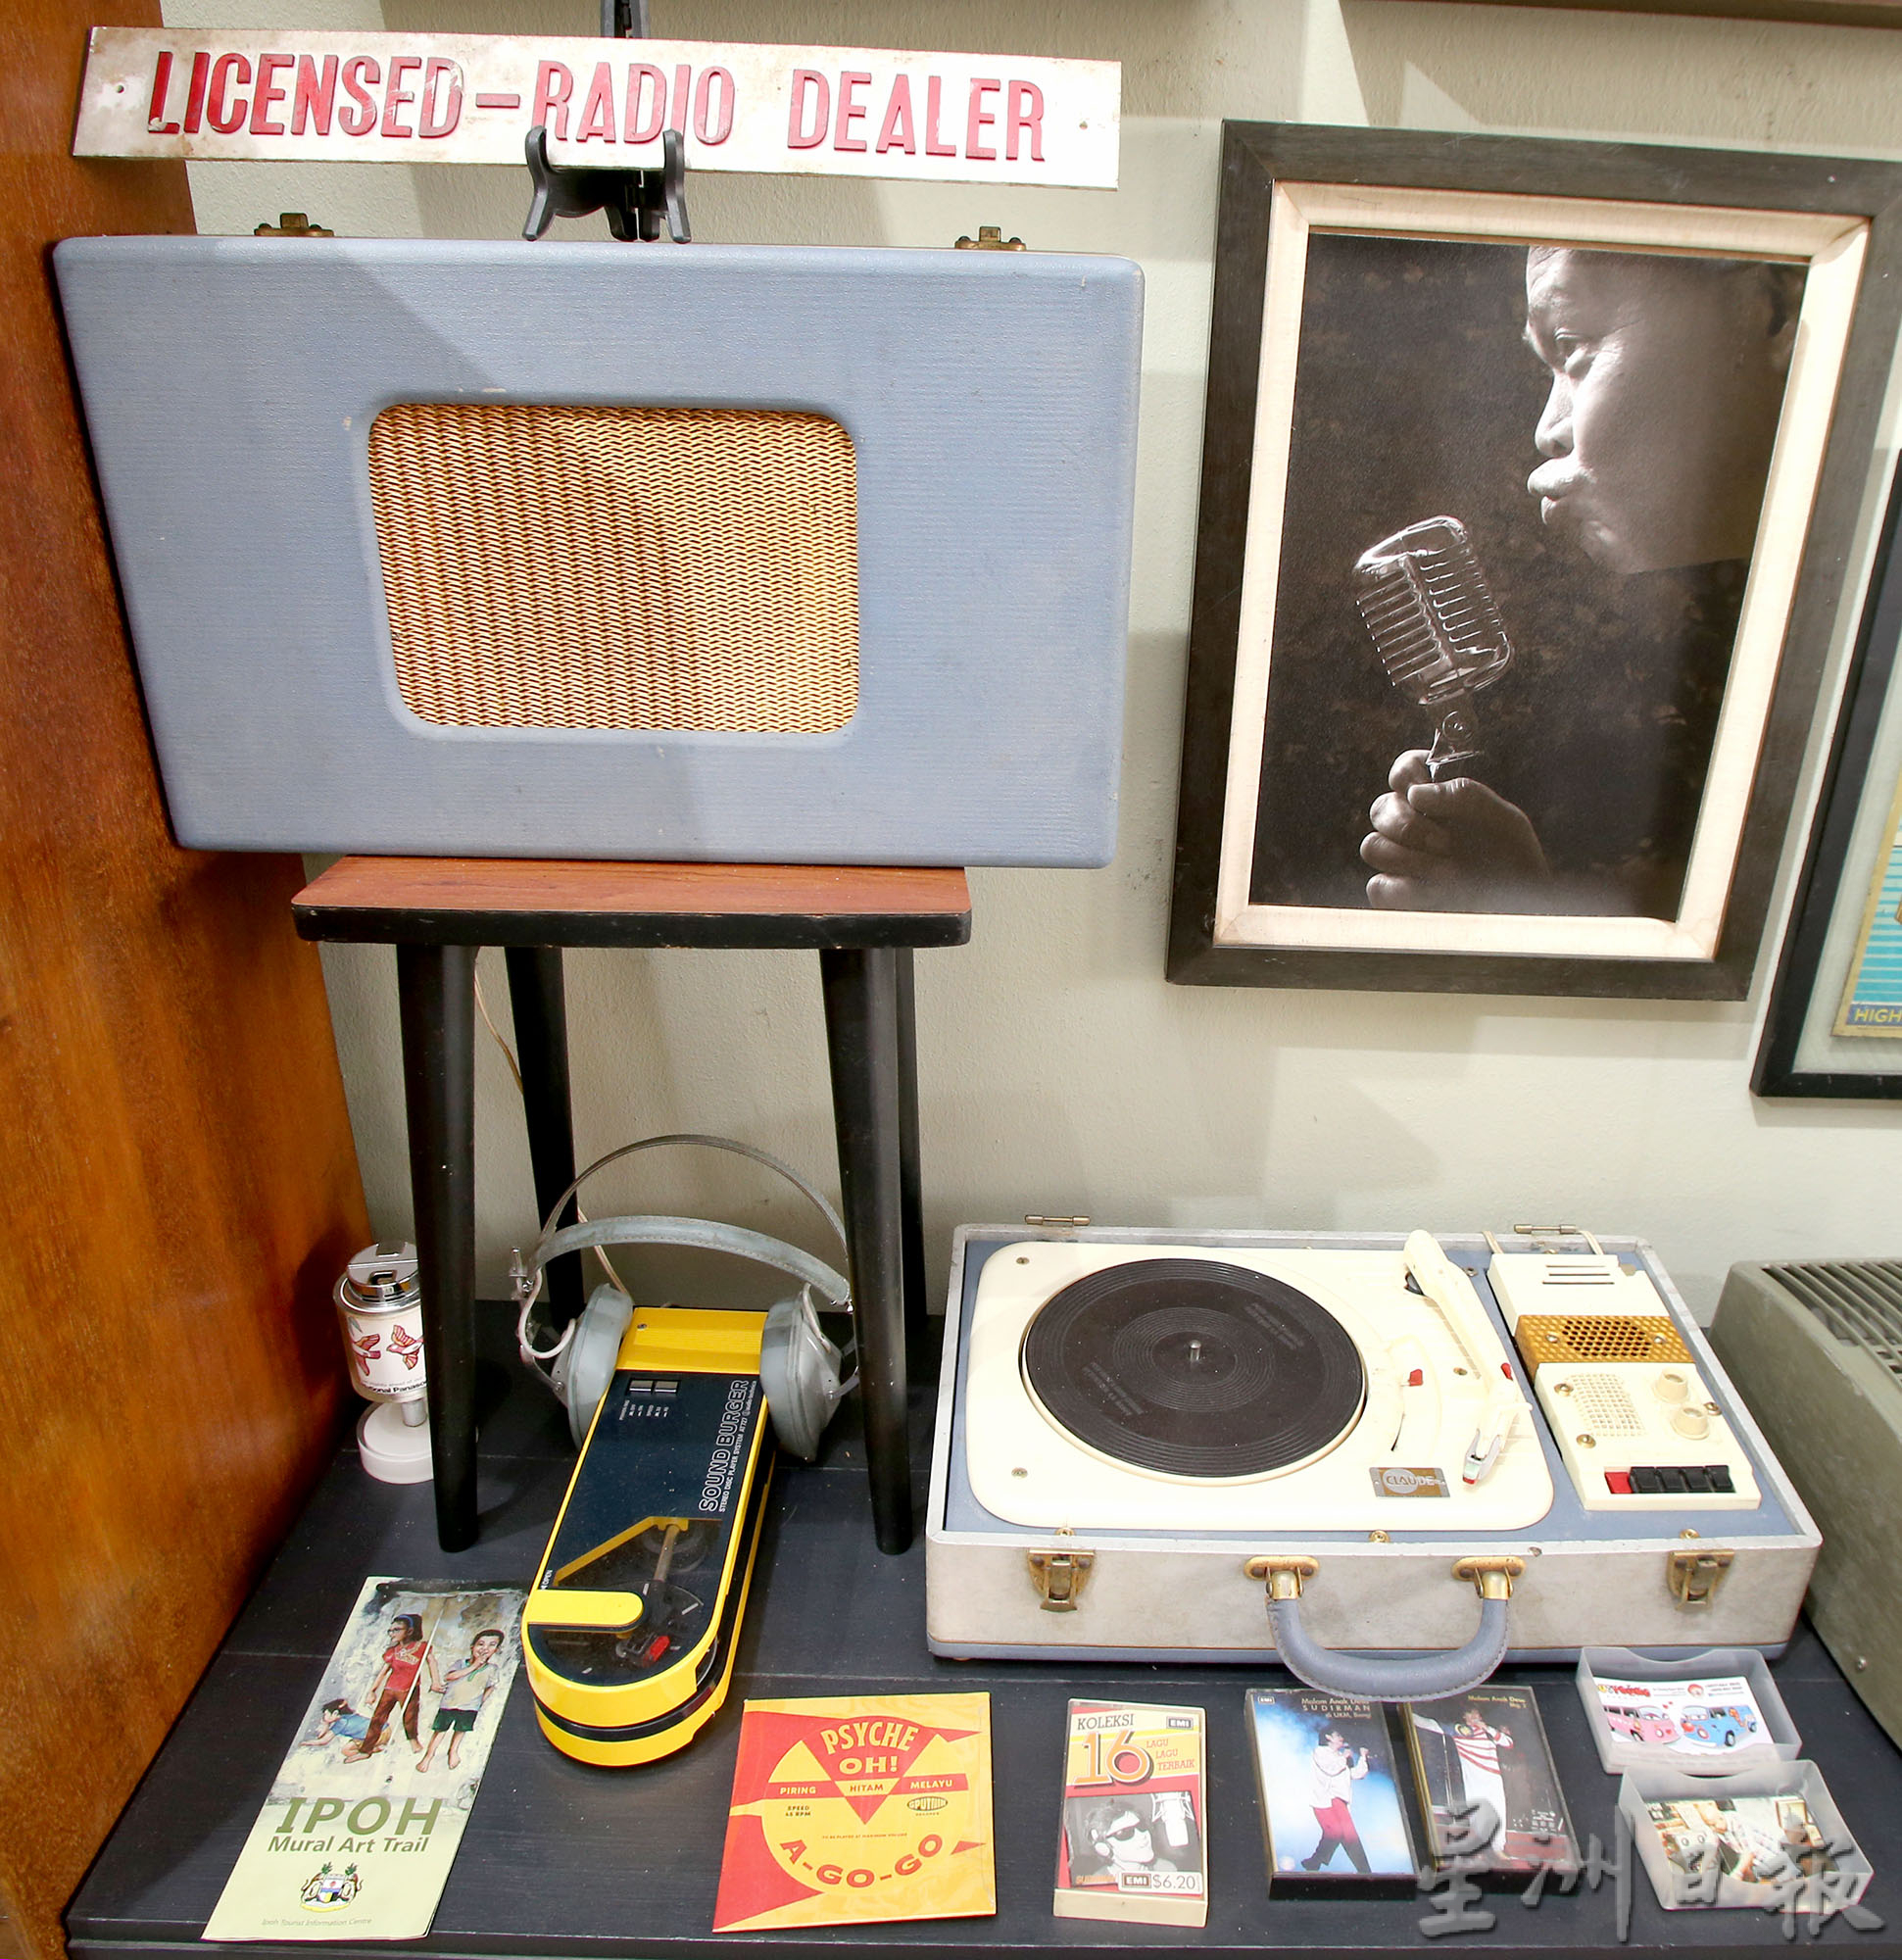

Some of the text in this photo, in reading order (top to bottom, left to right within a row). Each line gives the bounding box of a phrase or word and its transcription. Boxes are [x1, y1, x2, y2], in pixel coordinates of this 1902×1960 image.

[786, 69, 1046, 162] DEALER
[699, 1379, 750, 1512] SOUND BURGER
[733, 1434, 744, 1454] SYSTEM
[728, 1455, 739, 1476] PLAYER
[724, 1476, 734, 1490] DISC
[1386, 1475, 1436, 1486] CLAUDE
[718, 1491, 730, 1512] STEREO
[1077, 1714, 1135, 1730] KOLEKSI
[1170, 1719, 1190, 1728] EMI
[820, 1721, 921, 1755] PSYCHE
[1146, 1739, 1169, 1748] LAGU
[1073, 1730, 1154, 1788] 16
[1155, 1748, 1178, 1758] LAGU
[839, 1756, 899, 1775] OH!
[1157, 1759, 1195, 1771] TERBAIK
[780, 1779, 953, 1794] PIRING HITAM MELAYU
[275, 1796, 442, 1836] IPOH
[268, 1836, 431, 1853] Mural Art Trail
[780, 1834, 943, 1888] A-GO-GO
[1125, 1876, 1148, 1886] EMI
[1152, 1873, 1195, 1889] $6.20
